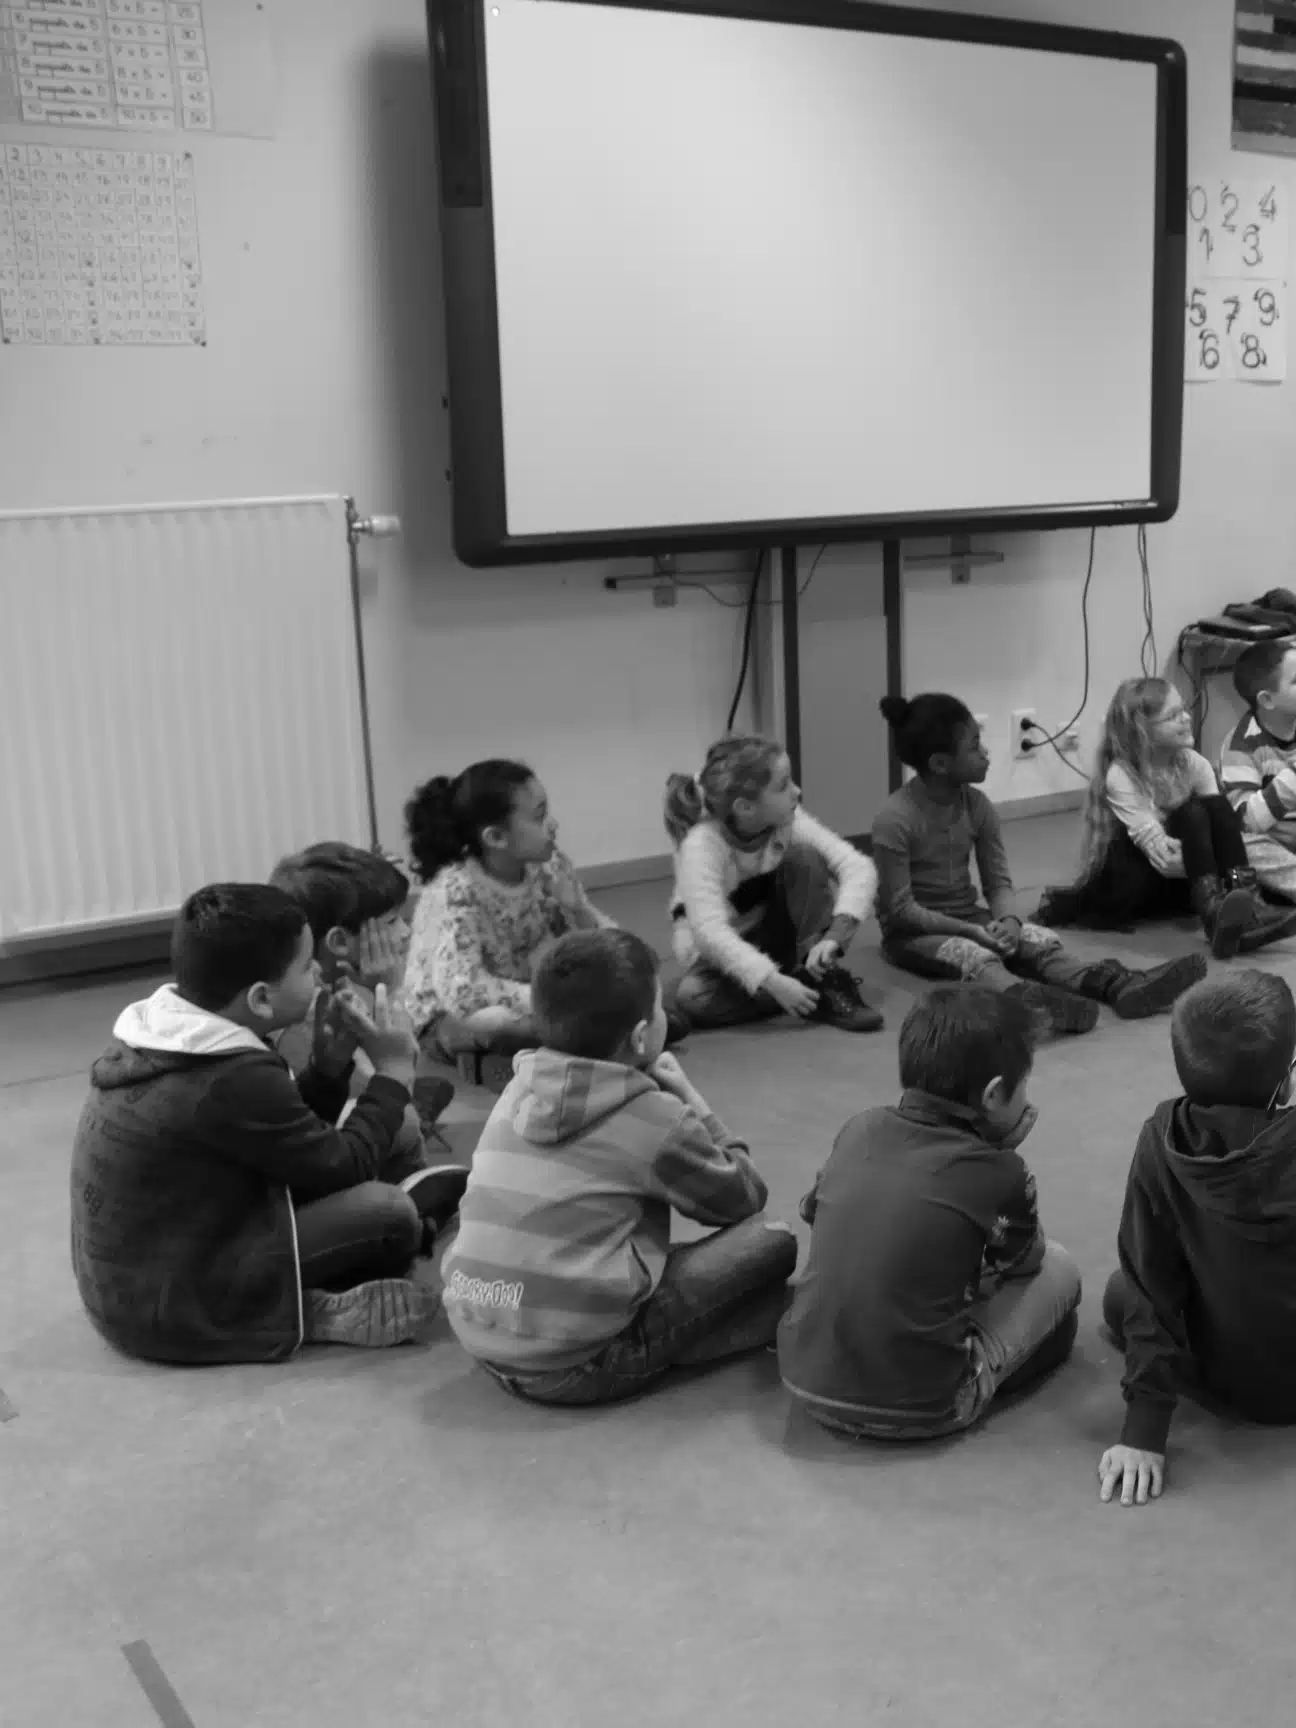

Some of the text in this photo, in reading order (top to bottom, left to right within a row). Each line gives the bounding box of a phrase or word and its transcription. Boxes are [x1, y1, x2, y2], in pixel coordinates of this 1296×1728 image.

[1221, 187, 1239, 233] 2
[1259, 185, 1277, 223] 4
[1199, 223, 1263, 267] 1 3
[1189, 287, 1277, 334] 5 7 9
[1200, 329, 1264, 370] 6 8
